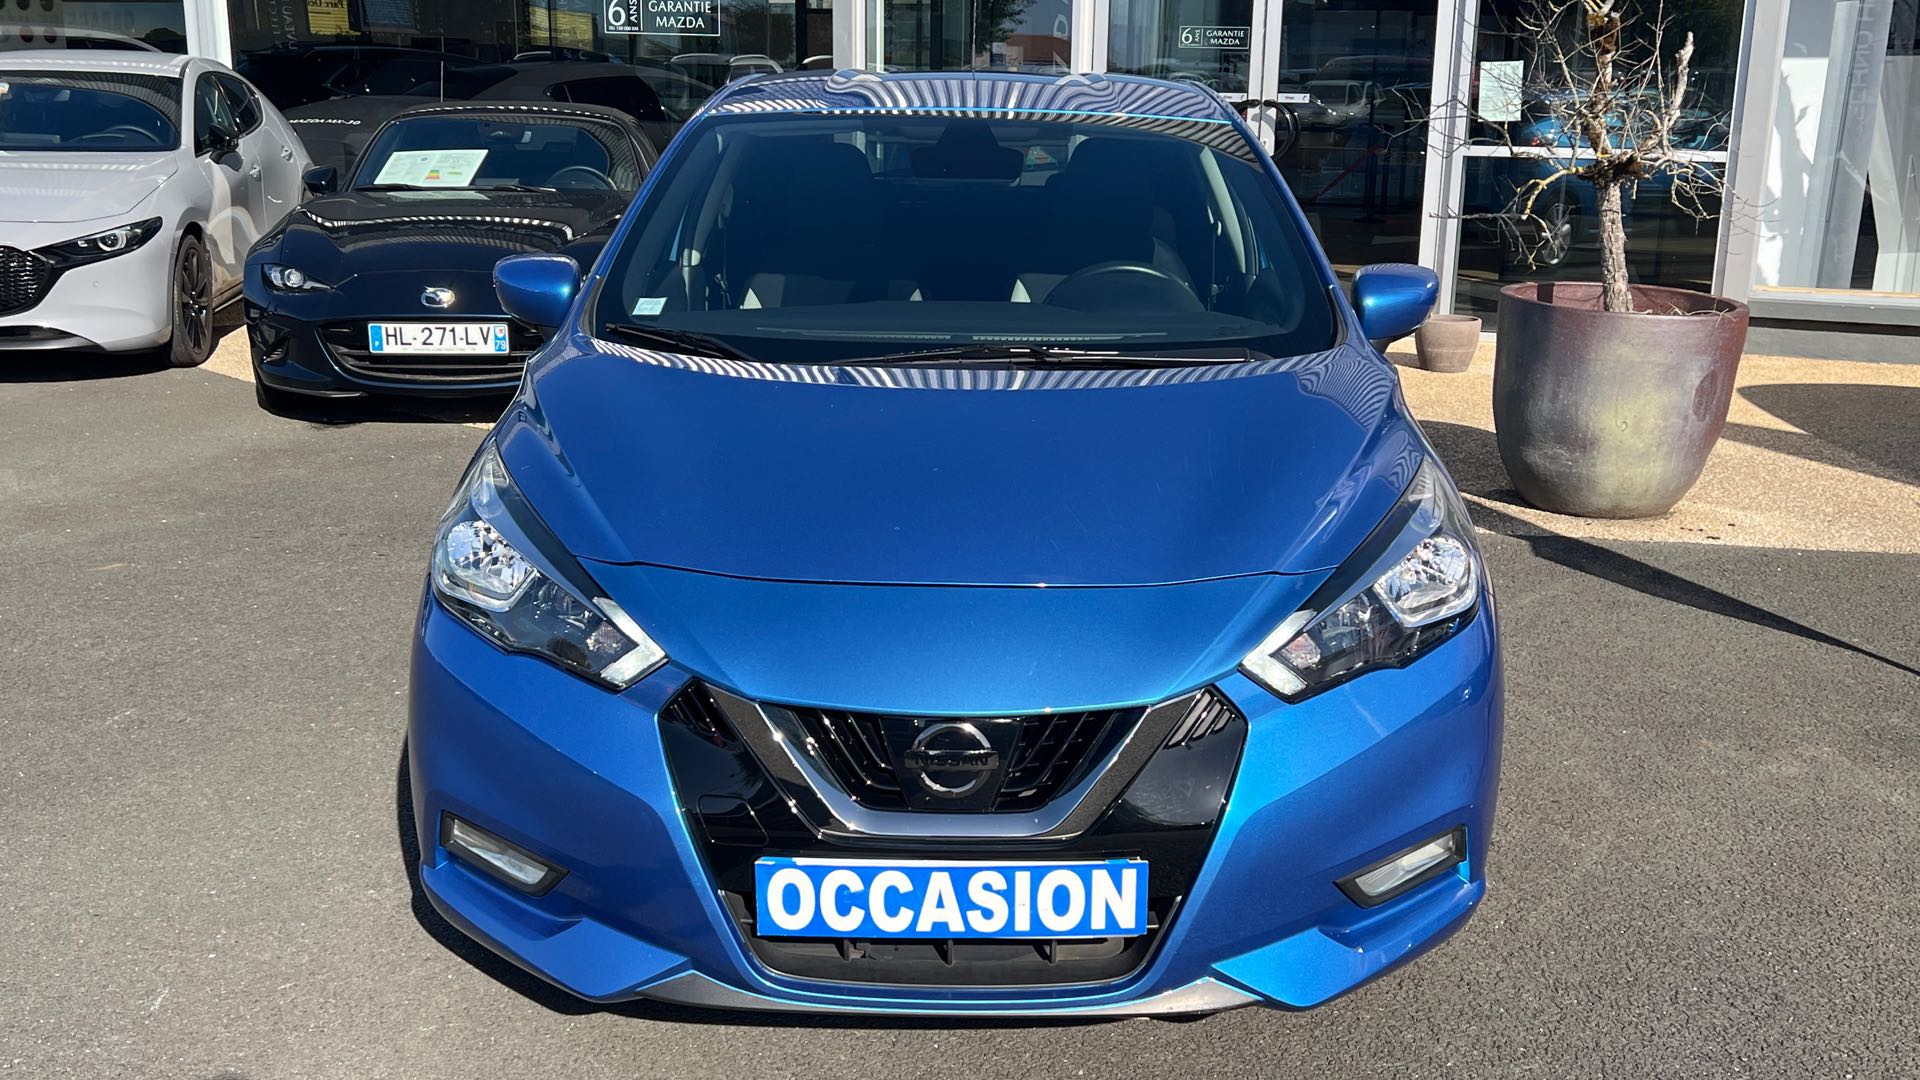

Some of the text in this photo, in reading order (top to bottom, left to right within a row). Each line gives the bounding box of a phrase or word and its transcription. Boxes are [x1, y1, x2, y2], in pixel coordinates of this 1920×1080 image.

[608, 0, 626, 26] 6
[629, 0, 638, 23] ANS
[648, 0, 711, 13] GARANTIE
[656, 16, 705, 29] MAZDA
[1181, 27, 1193, 44] 6
[495, 340, 506, 350] 79
[914, 755, 988, 767] NISSAN
[767, 867, 1138, 933] OCCASION
